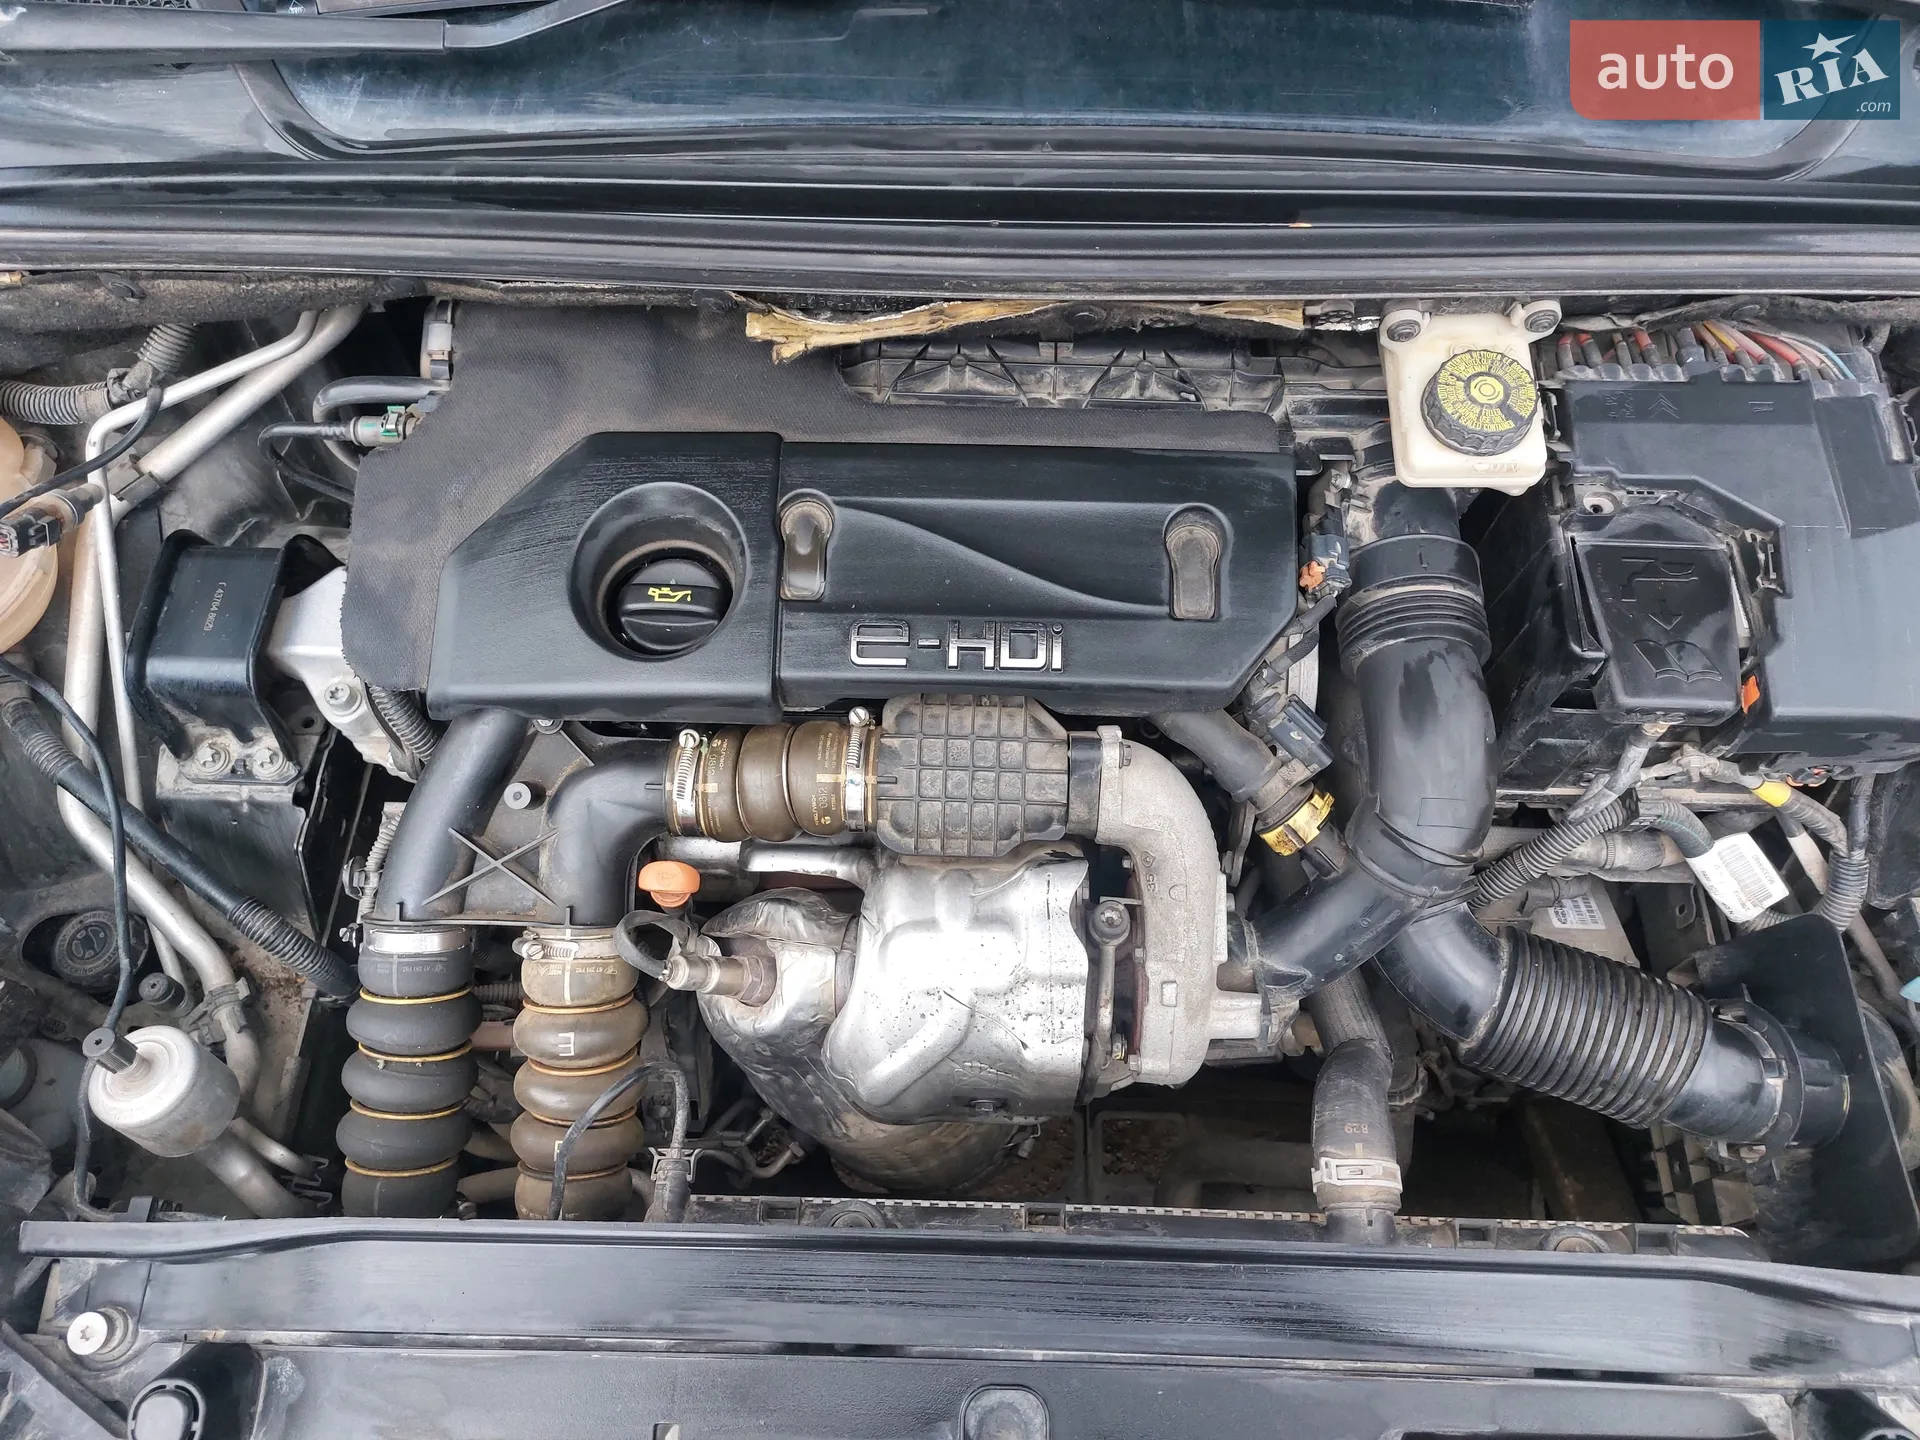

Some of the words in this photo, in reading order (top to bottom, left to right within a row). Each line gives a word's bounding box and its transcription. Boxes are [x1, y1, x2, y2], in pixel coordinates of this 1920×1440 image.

[1470, 351, 1501, 361] NETTOYER
[1501, 356, 1512, 365] CE
[1438, 384, 1448, 399] FLUID
[1457, 415, 1481, 430] SEALED
[1481, 408, 1503, 417] FILLER
[1478, 416, 1490, 424] USE
[1492, 414, 1508, 424] ONLY
[849, 619, 1064, 673] e-HDi
[1146, 873, 1157, 892] 35
[1344, 1123, 1369, 1134] 829
